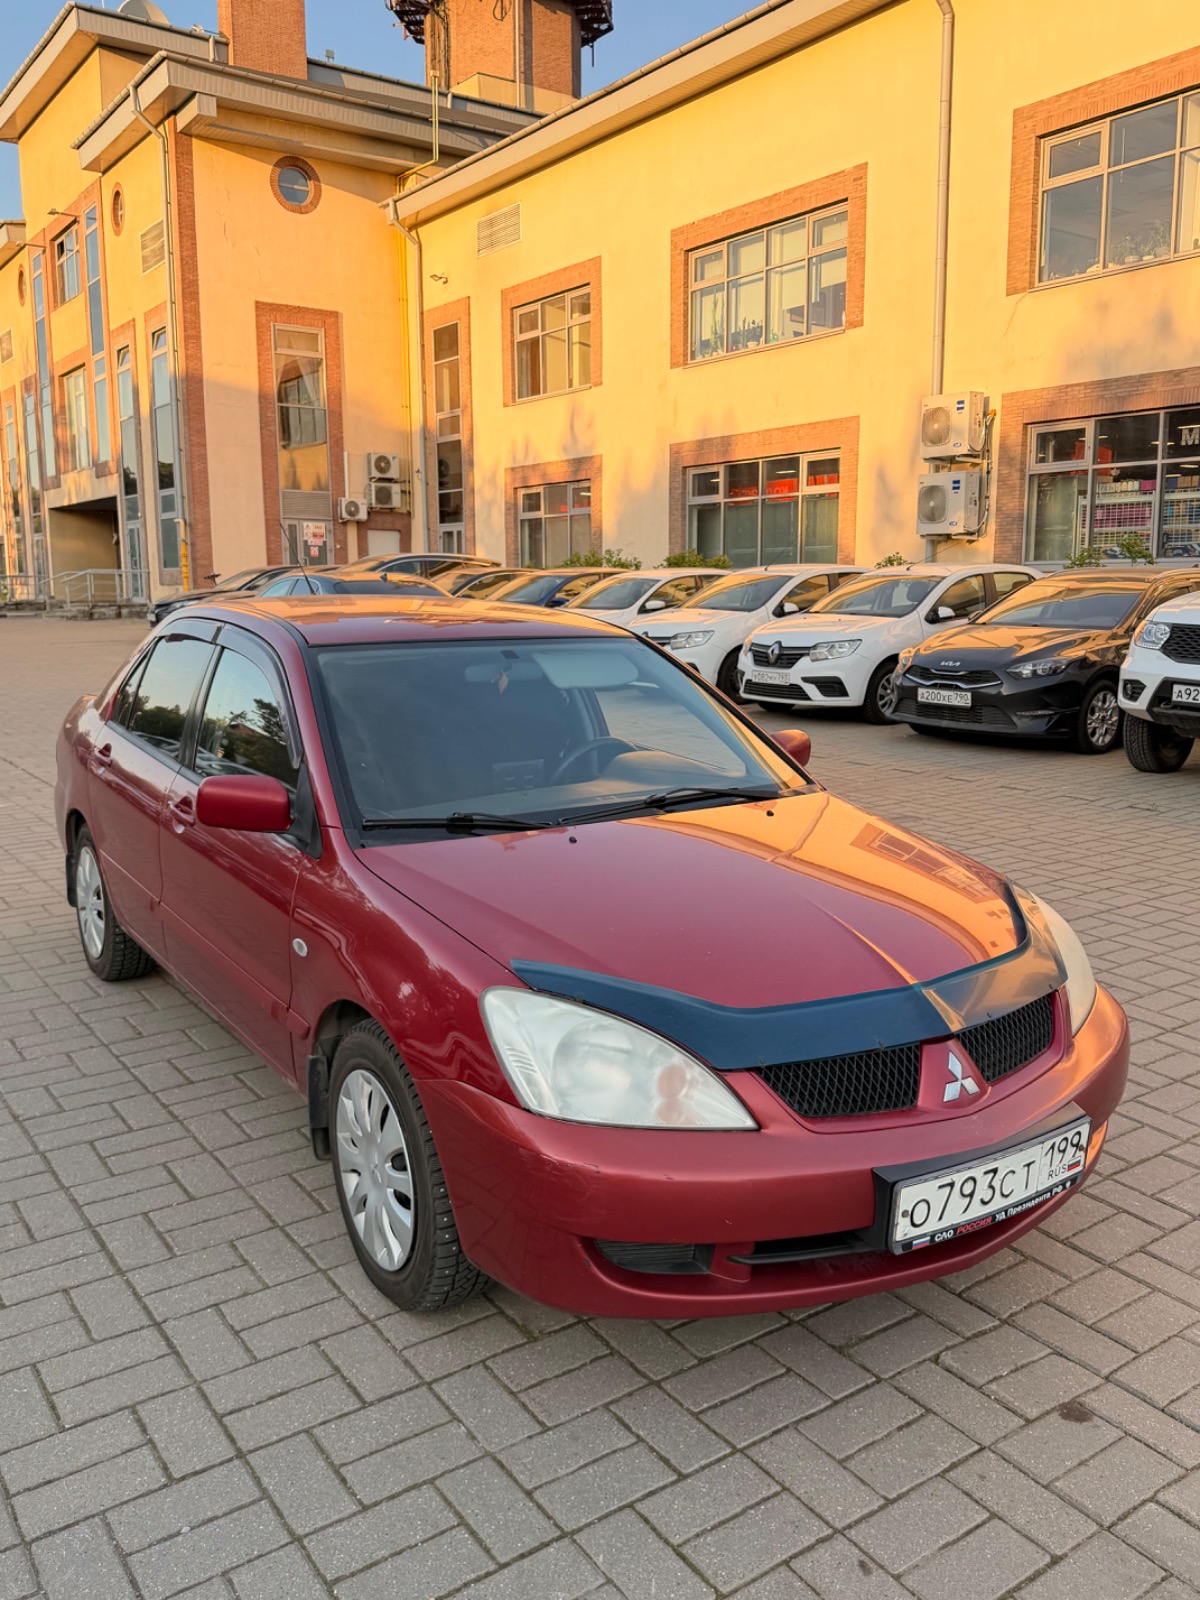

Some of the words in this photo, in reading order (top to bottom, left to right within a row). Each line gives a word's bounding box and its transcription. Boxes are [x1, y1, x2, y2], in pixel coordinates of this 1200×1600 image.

[909, 1159, 1036, 1229] О793СТ
[1044, 1130, 1082, 1169] 199
[1047, 1163, 1067, 1180] RUS
[956, 1216, 993, 1235] РОССИЯ
